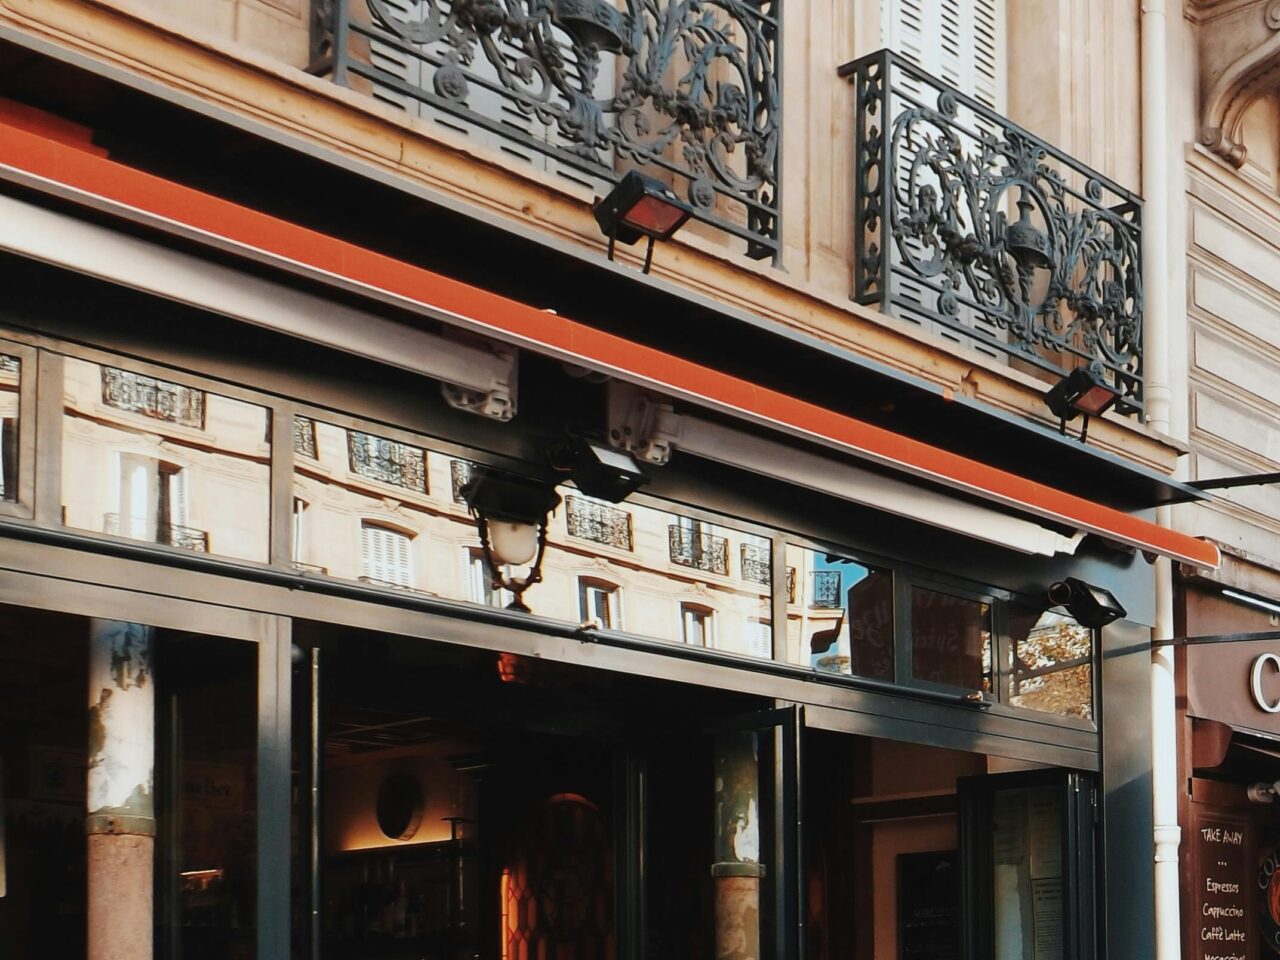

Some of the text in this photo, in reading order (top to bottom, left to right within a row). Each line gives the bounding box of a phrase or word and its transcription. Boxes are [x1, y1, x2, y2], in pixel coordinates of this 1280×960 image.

[1201, 828, 1243, 845] TAKE AWAY
[1207, 878, 1239, 893] Espressos
[1203, 903, 1243, 918] Cappuccino
[1225, 928, 1245, 942] Latte
